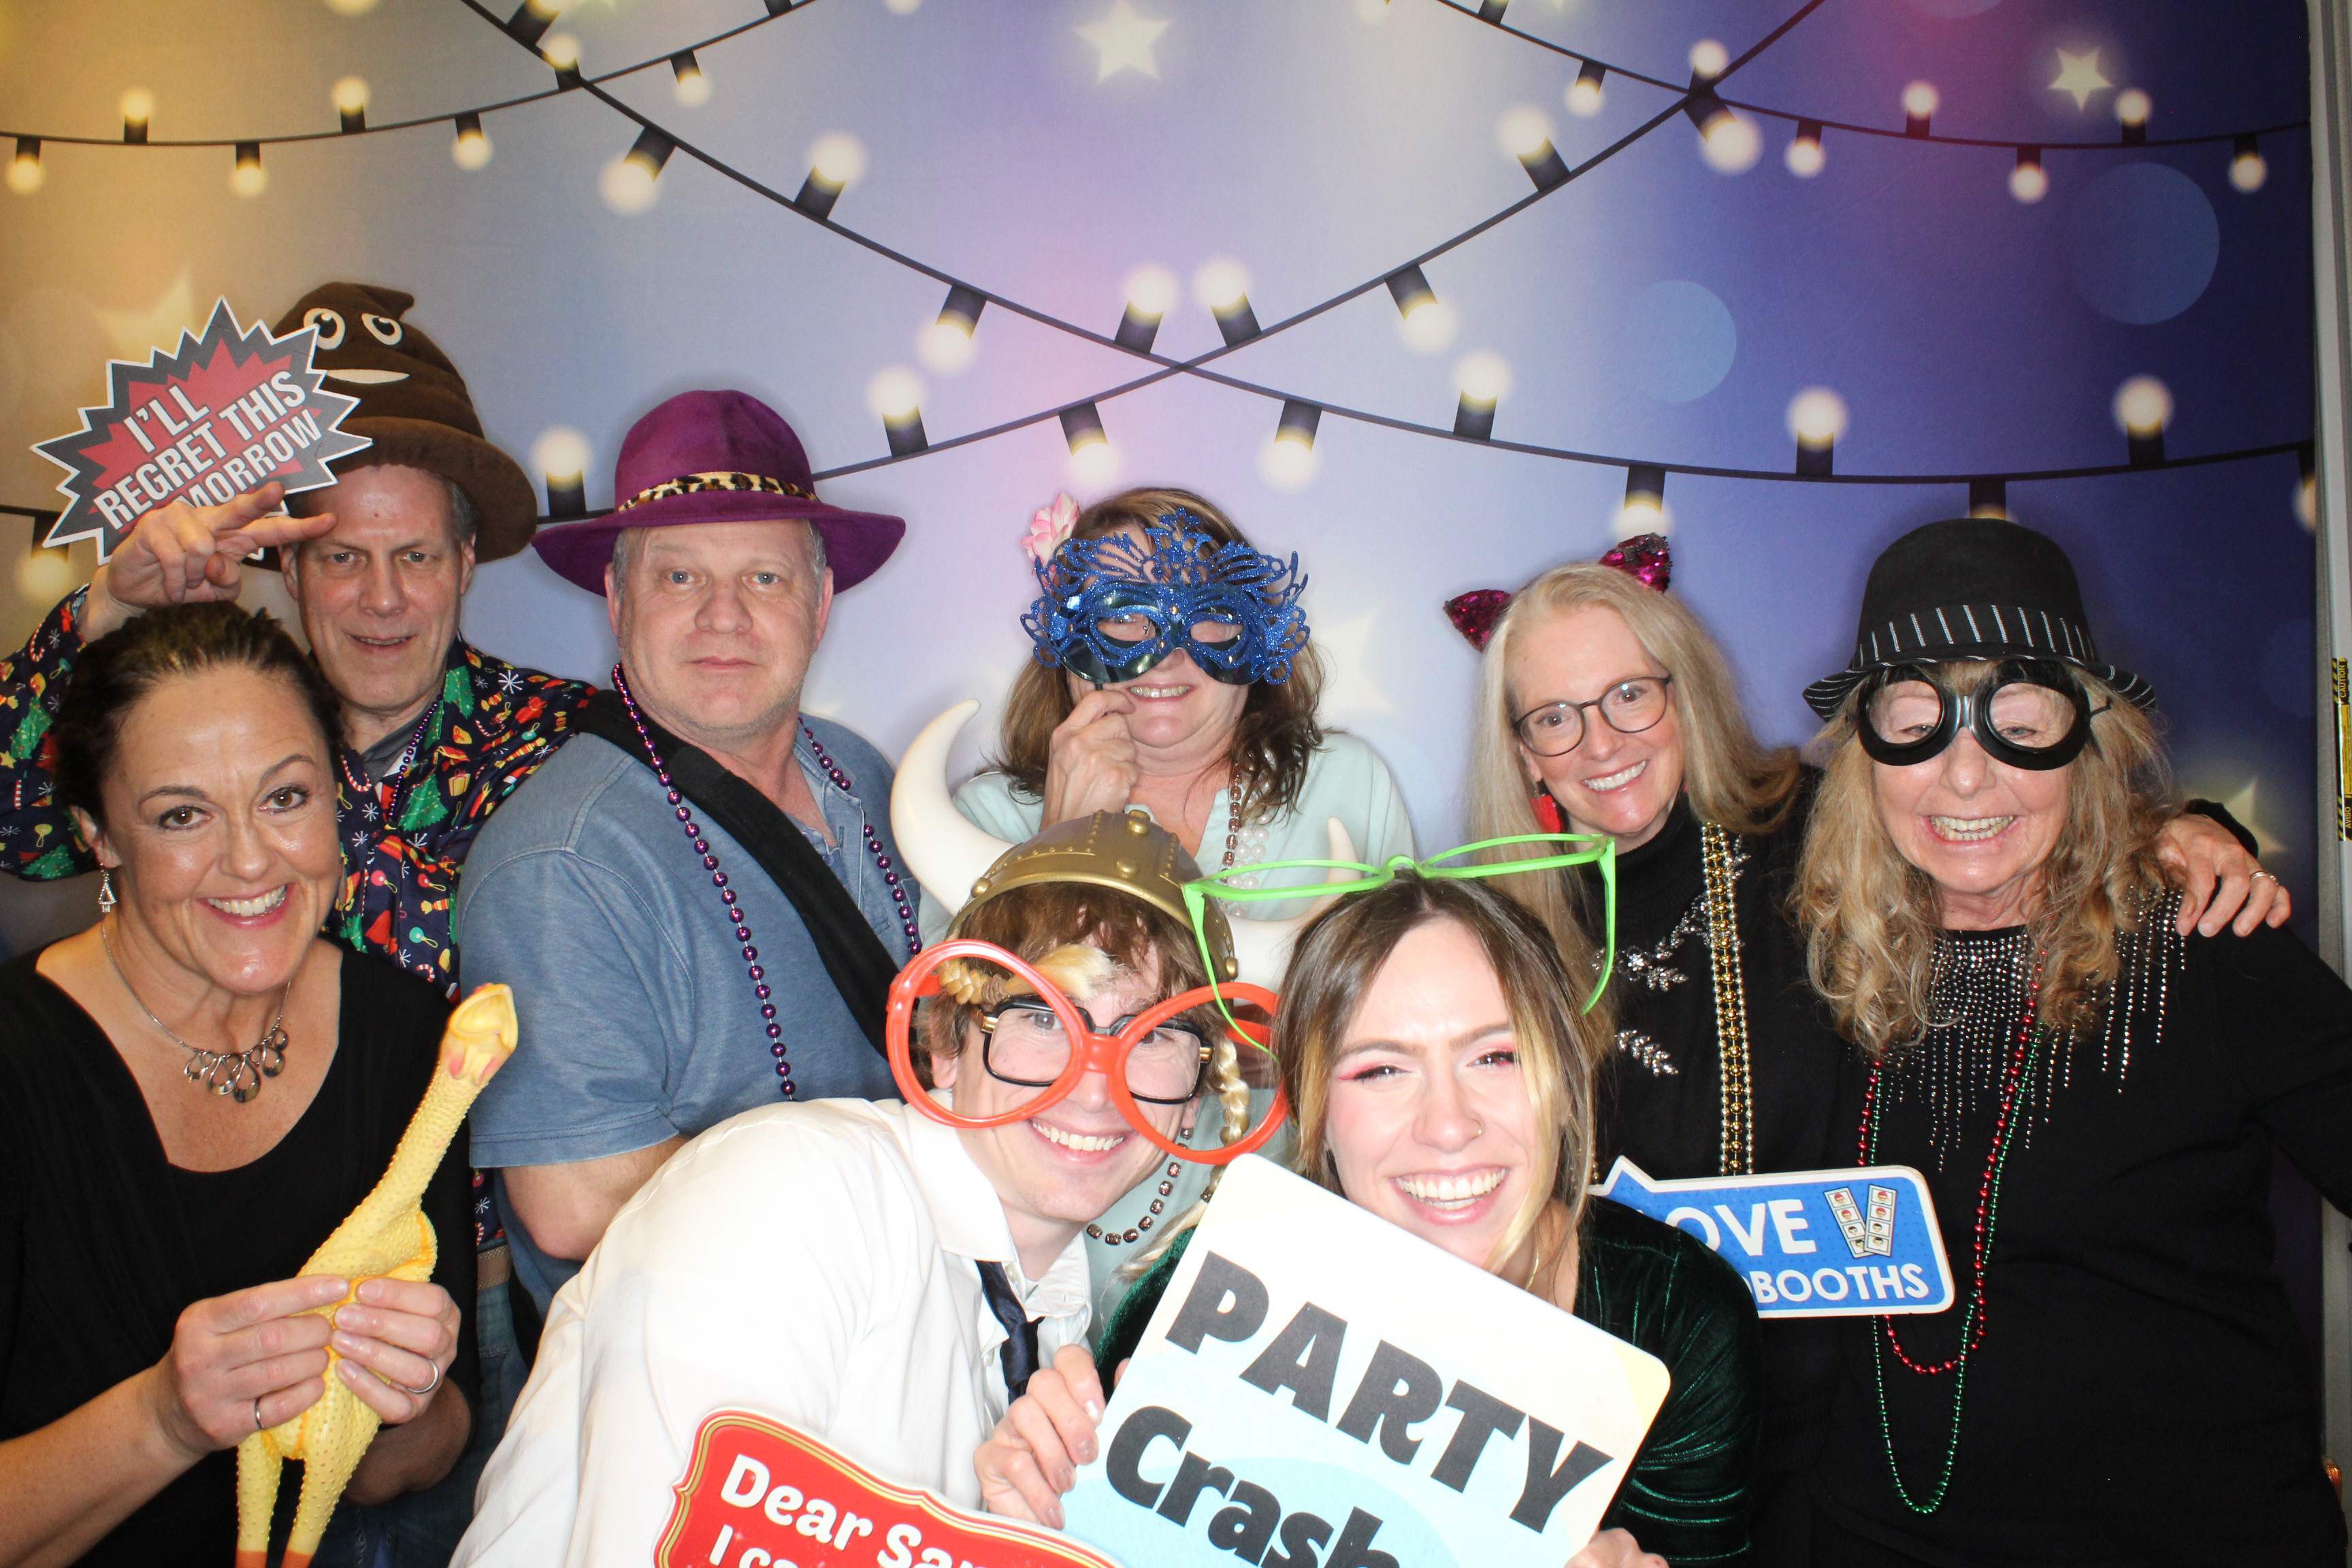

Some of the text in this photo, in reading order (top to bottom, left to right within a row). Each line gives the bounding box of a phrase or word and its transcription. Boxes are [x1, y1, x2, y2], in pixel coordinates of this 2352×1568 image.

[93, 370, 306, 529] REGRET THIS
[123, 385, 209, 453] I'LL
[1637, 1198, 1816, 1256] OVE
[1742, 1263, 1929, 1303] BOOTHS
[1164, 1251, 1614, 1534] PARTY
[721, 1454, 873, 1552] Dear
